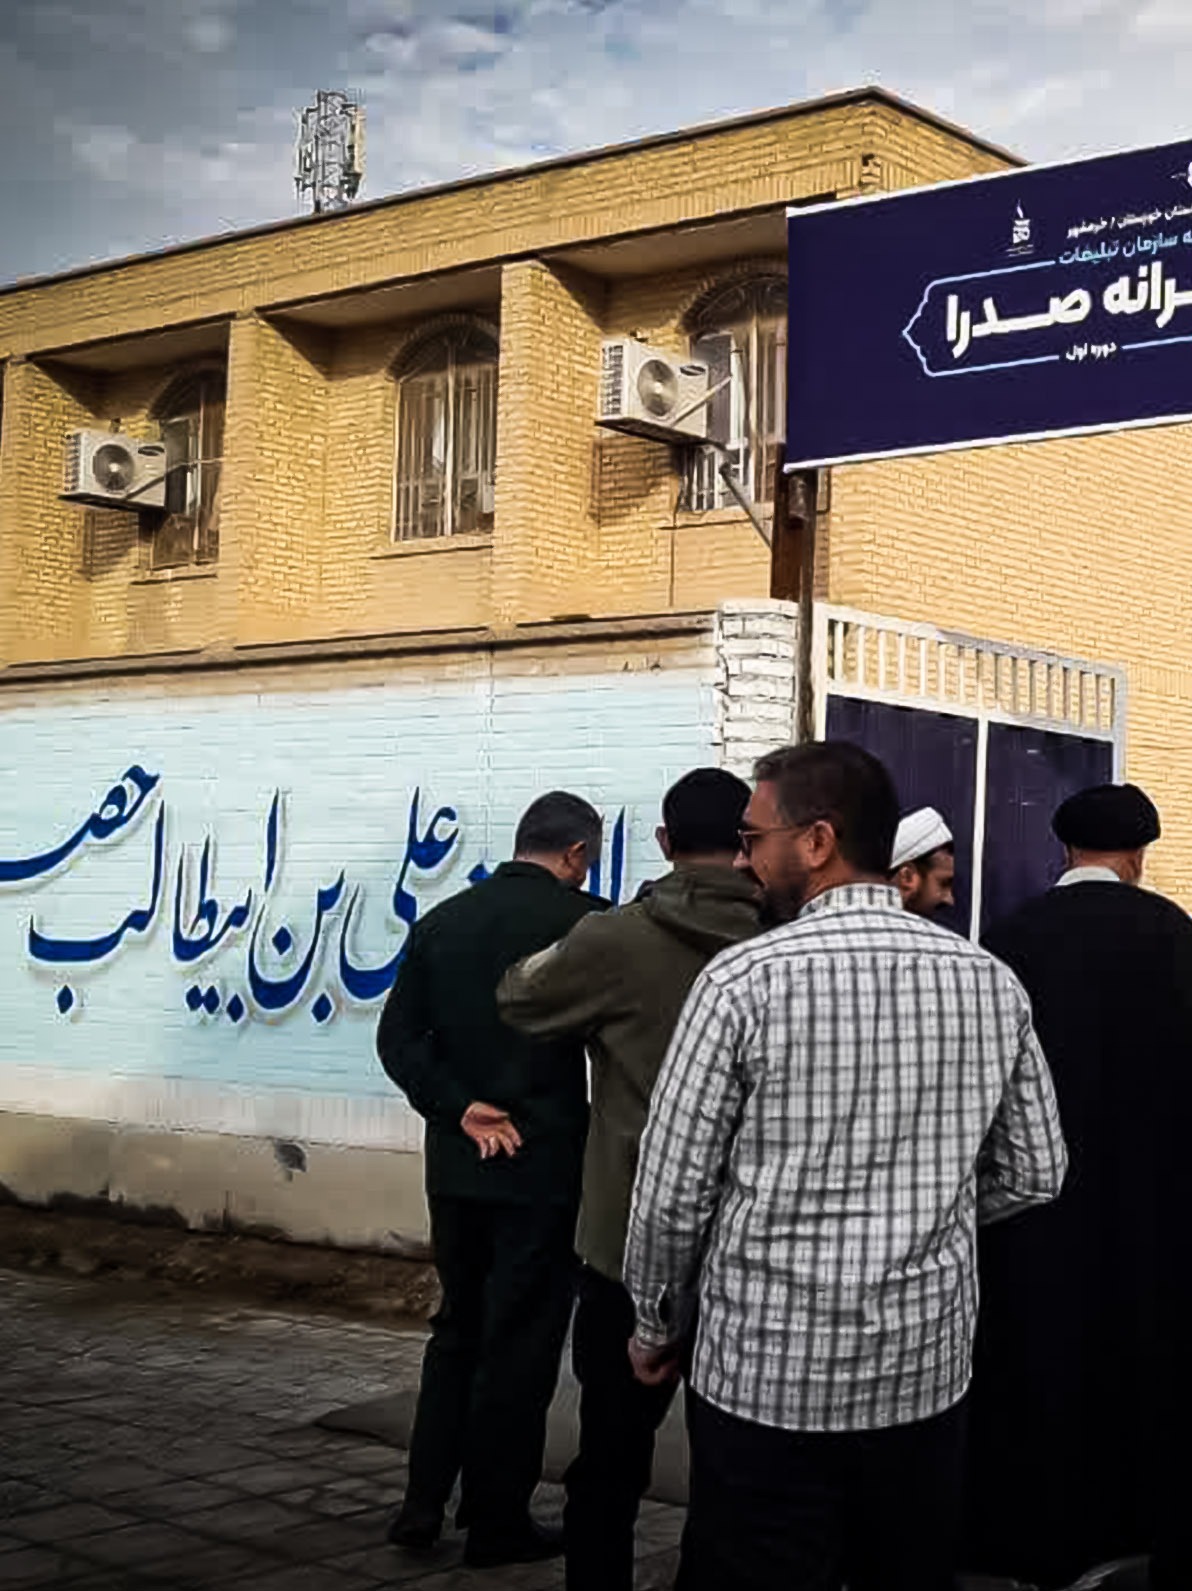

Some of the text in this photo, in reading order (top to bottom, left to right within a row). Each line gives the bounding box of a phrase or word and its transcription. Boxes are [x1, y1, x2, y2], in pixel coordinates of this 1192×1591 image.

[1058, 240, 1120, 264] تبلیغات
[1122, 232, 1179, 257] سازمان
[946, 288, 1091, 358] صدرا
[247, 869, 346, 1024] بن
